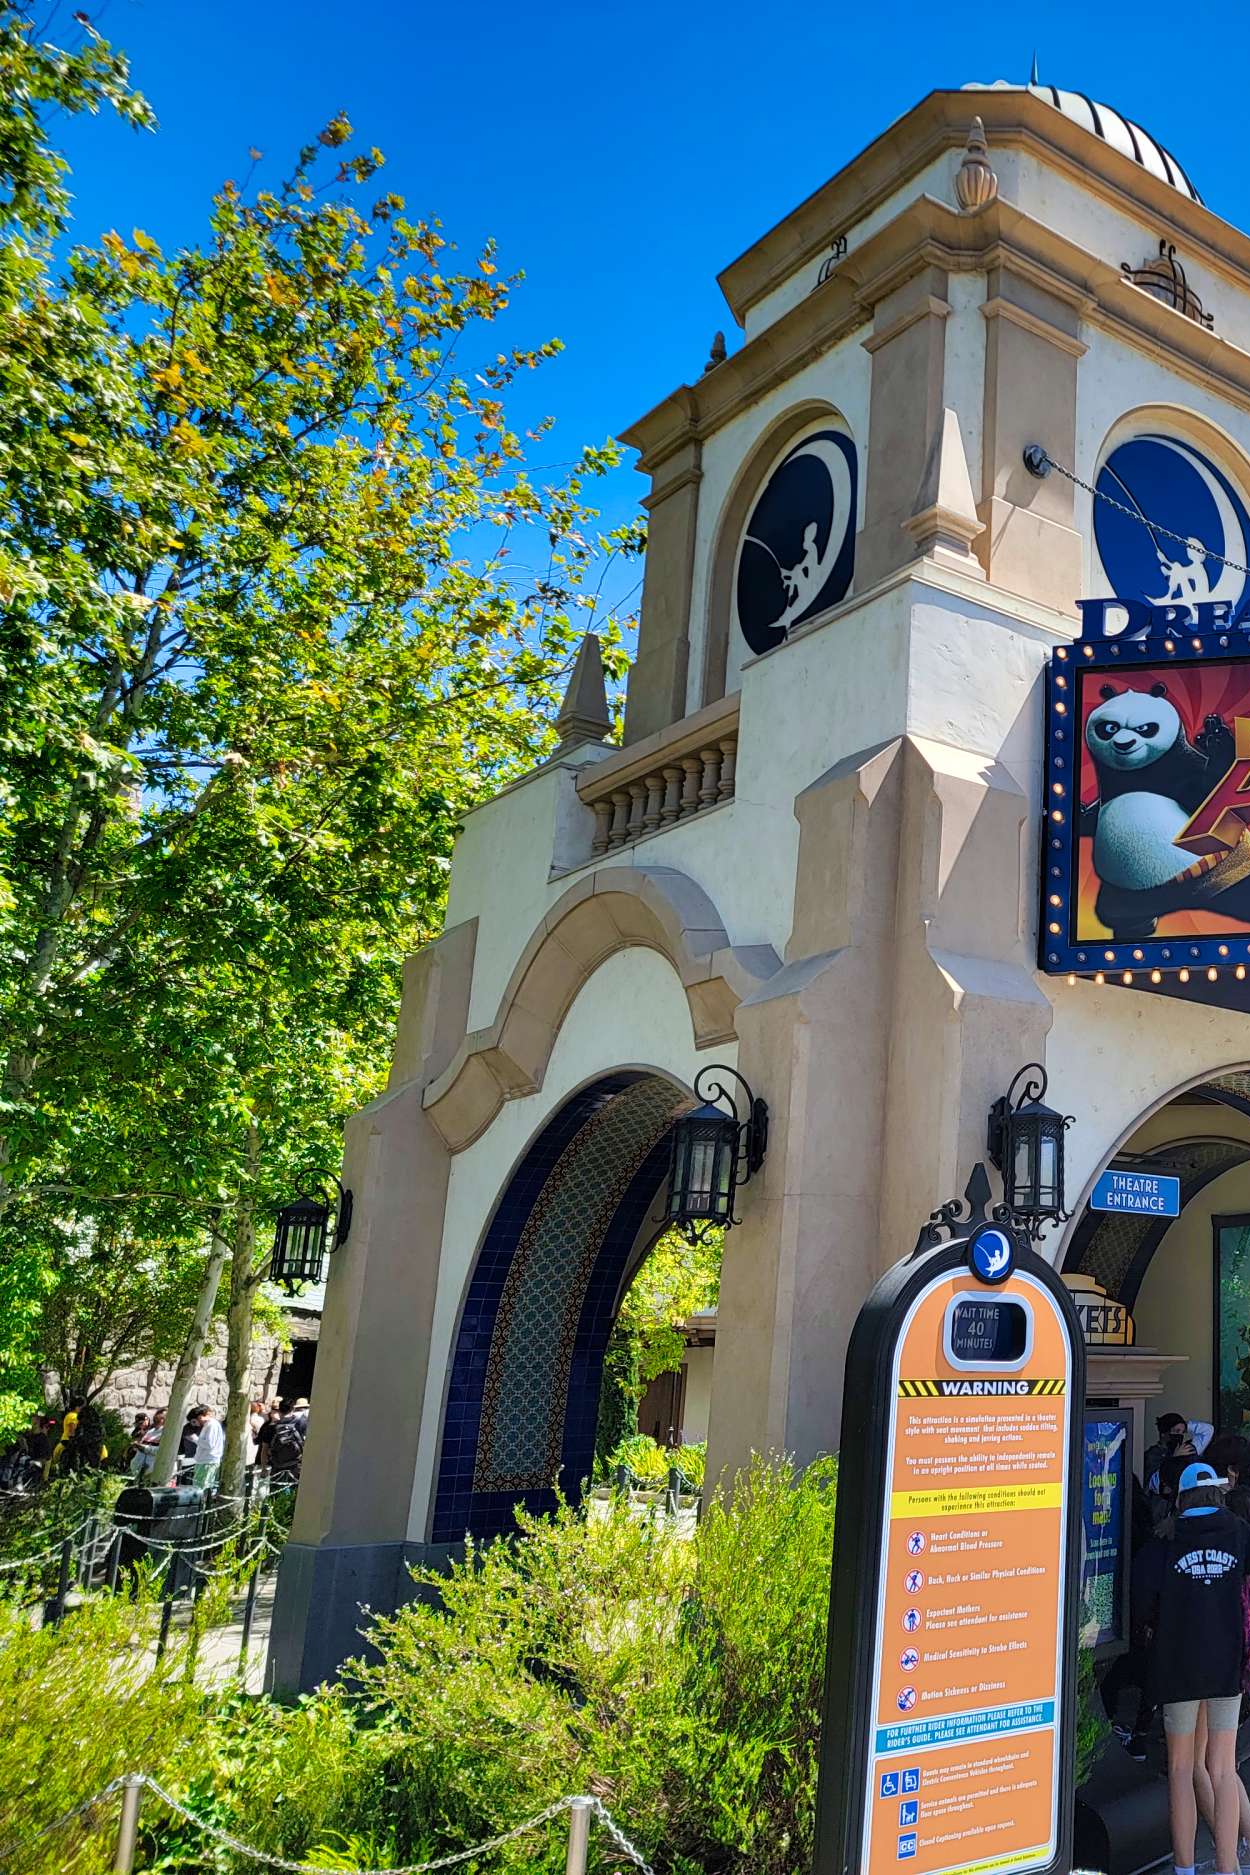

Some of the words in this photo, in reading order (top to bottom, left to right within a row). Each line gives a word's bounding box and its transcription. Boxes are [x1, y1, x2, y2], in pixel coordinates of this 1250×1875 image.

[1112, 1175, 1159, 1194] THEATRE
[1107, 1191, 1165, 1210] ENTRANCE
[979, 1308, 999, 1319] TIME
[968, 1322, 984, 1335] 40
[957, 1338, 993, 1348] MINUTES
[942, 1381, 1029, 1395] WARNING
[909, 1416, 921, 1424] This
[923, 1416, 951, 1424] attraction
[966, 1415, 996, 1423] simulation
[997, 1414, 1023, 1423] presented
[905, 1427, 920, 1436] style
[922, 1426, 935, 1434] with
[944, 1436, 967, 1445] shaking
[969, 1435, 980, 1443] and
[908, 1496, 931, 1504] Persons
[959, 1492, 986, 1501] following
[988, 1490, 1016, 1499] conditions
[1018, 1488, 1035, 1496] should
[942, 1502, 972, 1512] experience
[975, 1501, 985, 1509] this
[931, 1532, 948, 1541] Heart
[950, 1529, 980, 1539] Conditions
[930, 1543, 959, 1553] Abnormal
[960, 1542, 977, 1550] Blood
[979, 1540, 1002, 1549] Pressure
[1178, 1550, 1203, 1570] WEST
[1205, 1549, 1234, 1567] COAST
[928, 1576, 944, 1585] Back,
[970, 1572, 991, 1581] Similar
[992, 1568, 1015, 1579] Physical
[1016, 1566, 1046, 1575] Conditions
[1191, 1565, 1206, 1575] USA
[1207, 1564, 1223, 1574] 2022
[957, 1605, 981, 1614] Mothers
[926, 1620, 945, 1630] Please
[959, 1615, 988, 1626] attendant
[989, 1613, 997, 1622] for
[999, 1611, 1027, 1621] assistance
[924, 1652, 948, 1662] Medical
[949, 1647, 980, 1658] Sensitivity
[981, 1646, 988, 1654] to
[989, 1644, 1007, 1653] Strobe
[921, 1690, 943, 1700] Motion
[944, 1686, 969, 1697] Sickness
[971, 1684, 978, 1693] or
[979, 1681, 1006, 1691] Dizziness
[887, 1729, 898, 1737] FOR
[901, 1725, 927, 1736] FURTHER
[928, 1722, 945, 1731] RIDER
[947, 1715, 986, 1728] INFORMATION
[987, 1710, 1006, 1720] PLEASE
[1007, 1707, 1024, 1717] REFER
[1025, 1706, 1032, 1714] TO
[1034, 1704, 1043, 1713] THE
[912, 1733, 932, 1744] GUIDE.
[935, 1730, 954, 1740] PLEASE
[956, 1728, 965, 1736] SEE
[966, 1722, 998, 1734] ATTENDANT
[1000, 1720, 1010, 1728] FOR
[1011, 1714, 1044, 1726] ASSISTANCE.
[901, 1841, 914, 1851] CC
